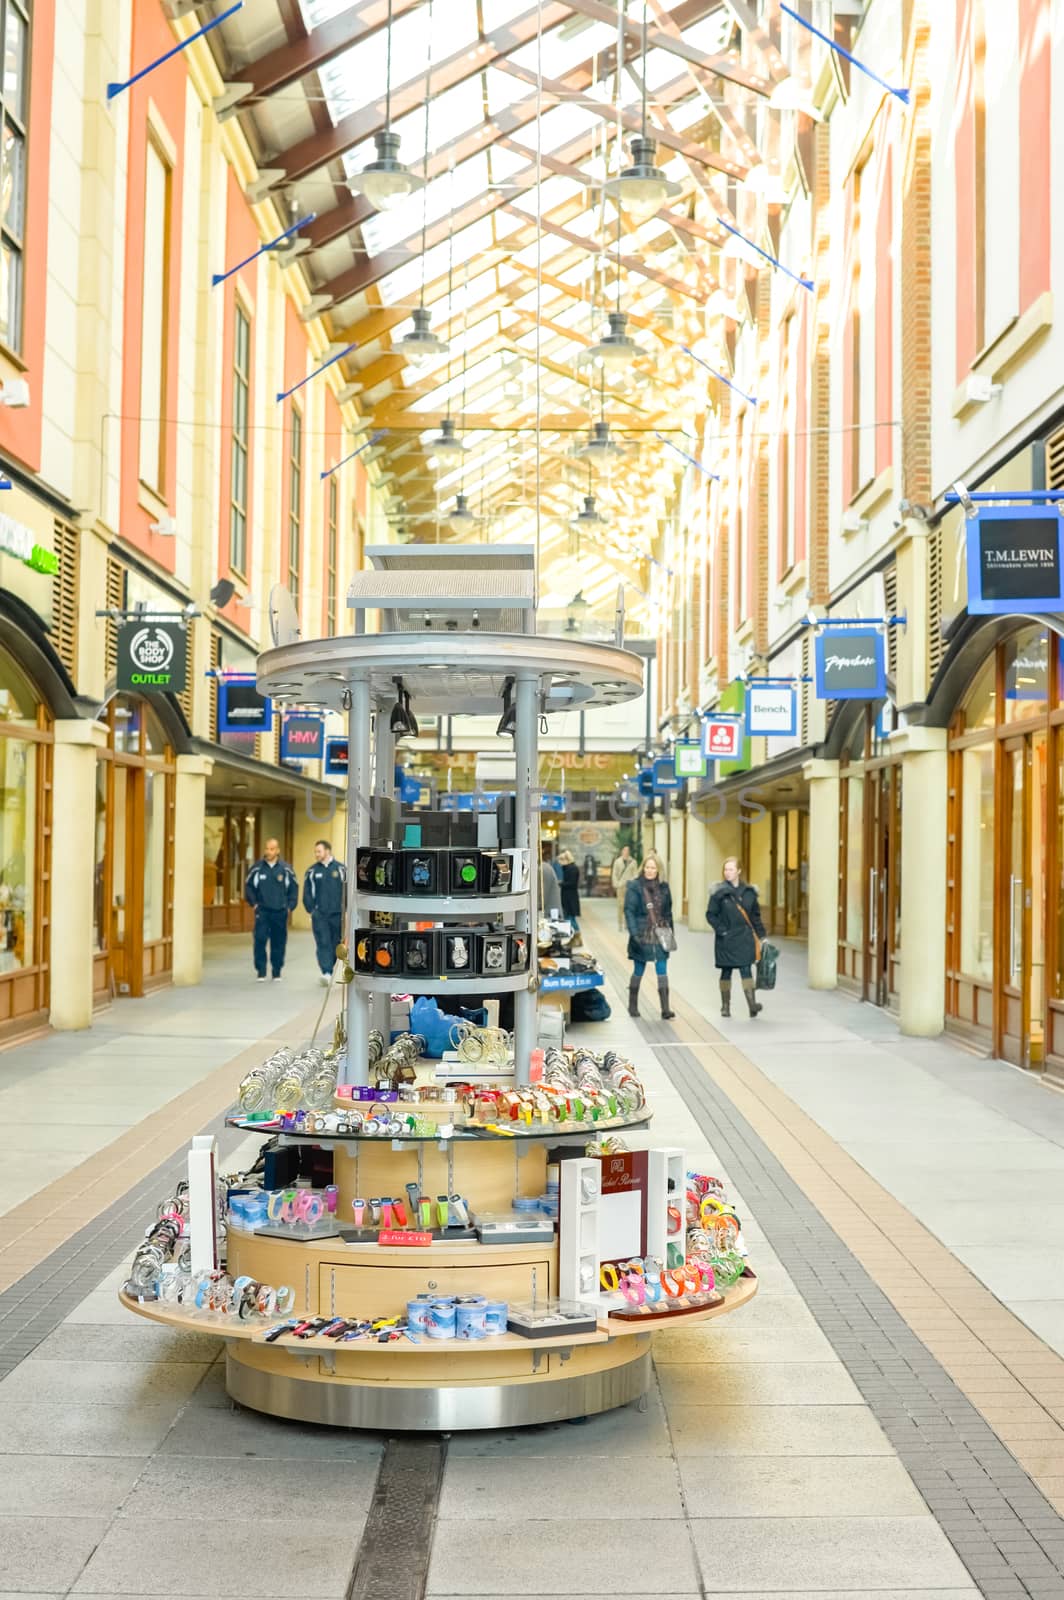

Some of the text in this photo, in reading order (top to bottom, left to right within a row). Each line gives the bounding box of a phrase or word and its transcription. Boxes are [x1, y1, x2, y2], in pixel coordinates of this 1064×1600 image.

[984, 549, 1054, 562] T.M.LEWIN
[139, 647, 165, 656] BODY
[140, 655, 164, 664] SHOP
[131, 673, 171, 684] OUTLET
[288, 730, 318, 744] HMV
